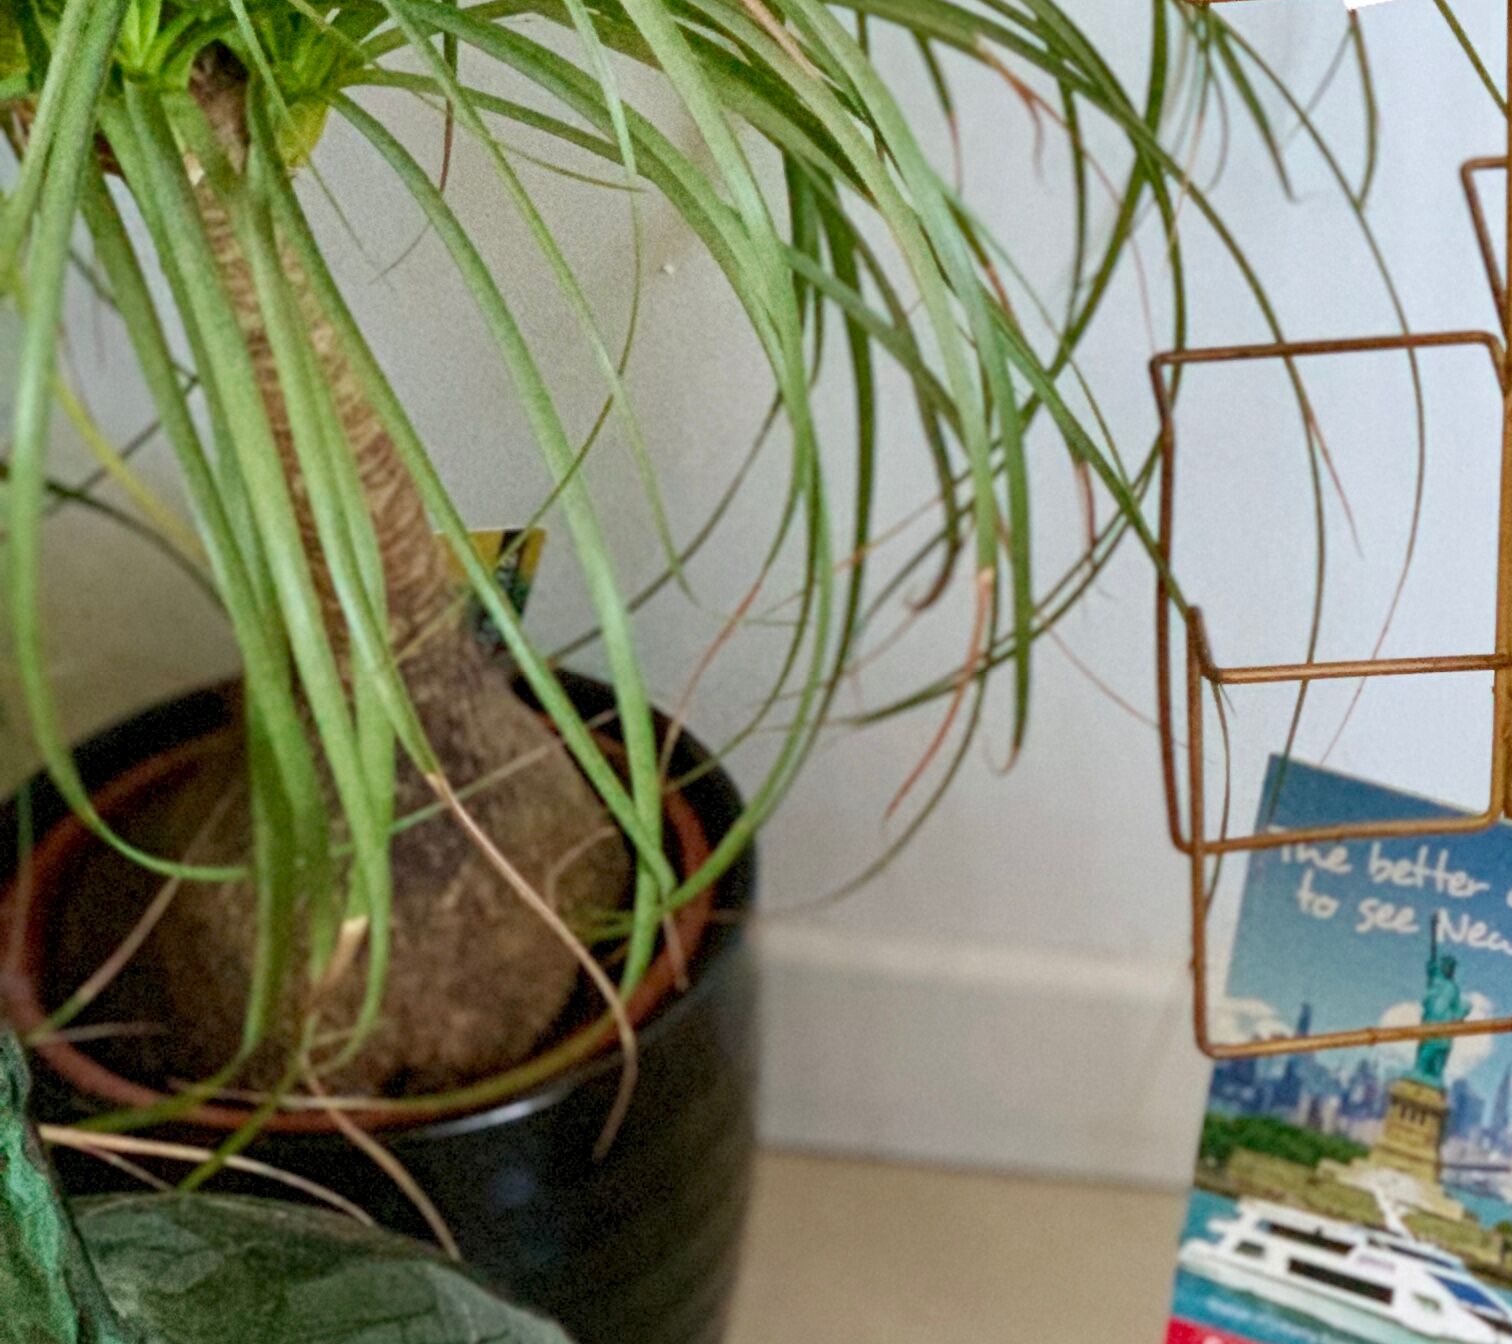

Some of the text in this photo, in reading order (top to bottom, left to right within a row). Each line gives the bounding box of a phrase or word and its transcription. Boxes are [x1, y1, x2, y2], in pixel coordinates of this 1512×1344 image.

[1368, 840, 1491, 898] better
[1296, 868, 1340, 920] to
[1354, 897, 1421, 934] see
